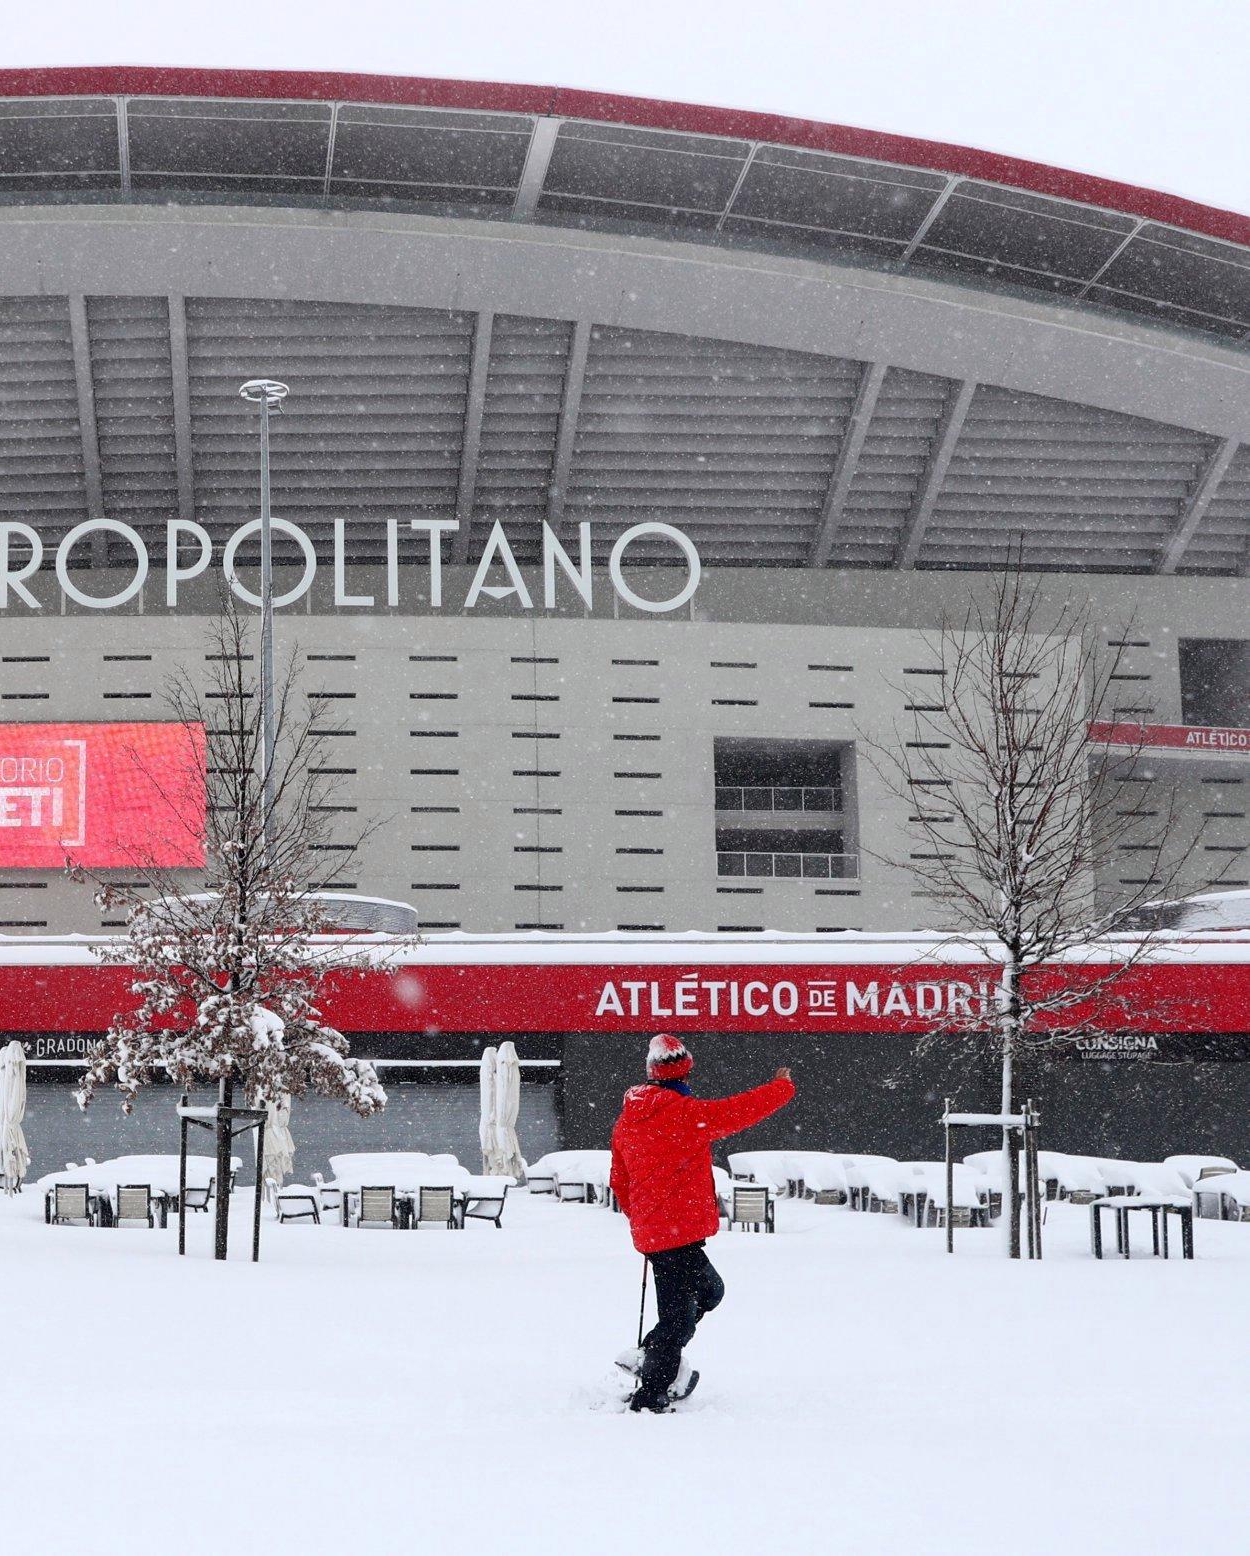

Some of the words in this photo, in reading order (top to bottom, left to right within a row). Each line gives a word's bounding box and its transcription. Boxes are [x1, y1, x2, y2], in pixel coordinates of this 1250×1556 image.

[1186, 730, 1247, 747] ATLÉTICO
[595, 973, 798, 1016] ATLÉTICO
[809, 990, 835, 1007] DE
[846, 978, 1006, 1016] MADRI
[1076, 1035, 1158, 1050] CONSIGNA
[1081, 1051, 1116, 1060] LUGGAGE
